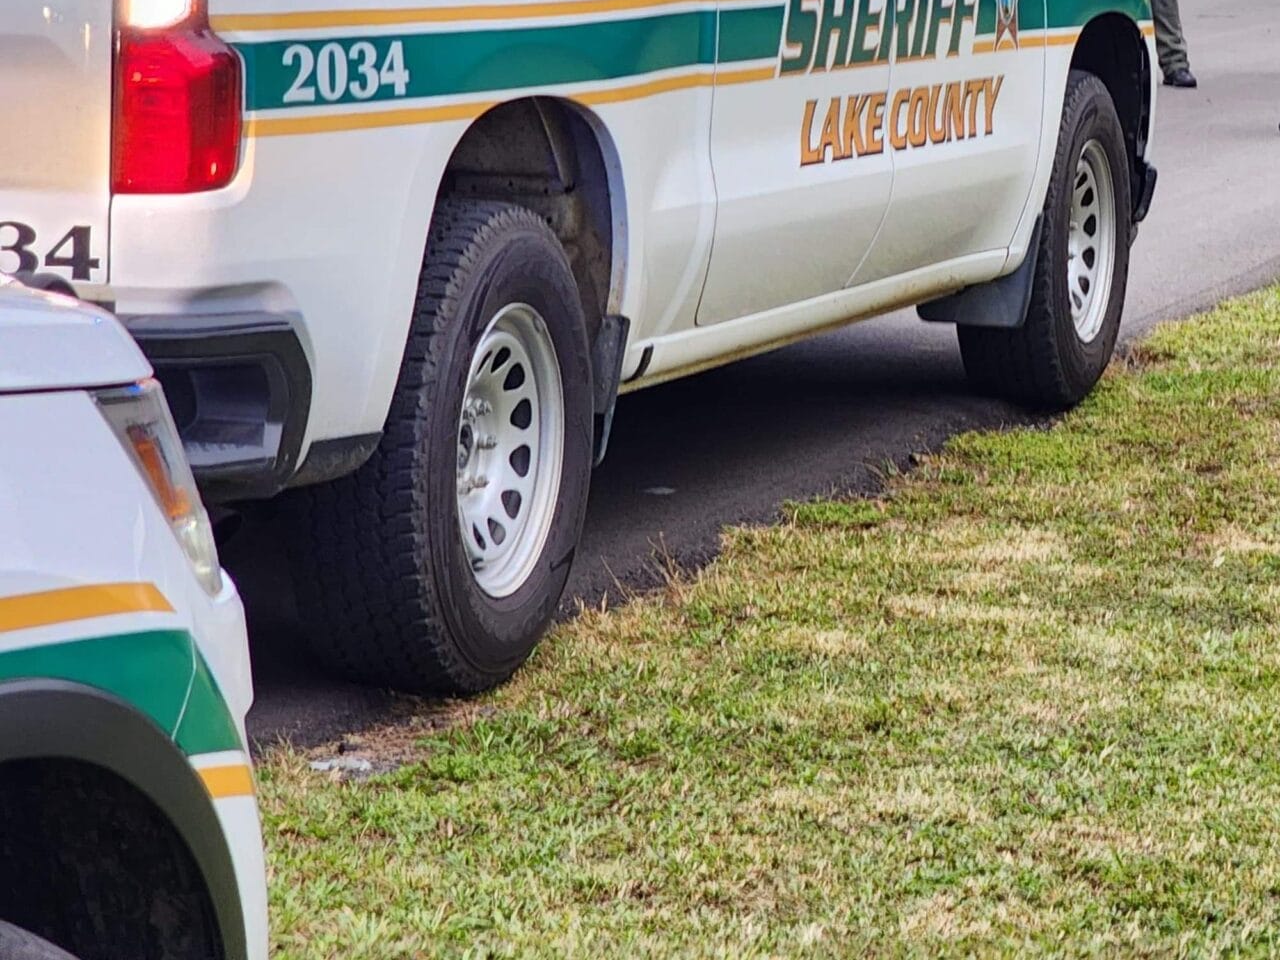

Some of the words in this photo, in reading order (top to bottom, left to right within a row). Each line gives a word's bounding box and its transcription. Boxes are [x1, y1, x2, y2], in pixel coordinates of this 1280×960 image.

[282, 40, 409, 103] 2034
[800, 91, 888, 167] LAKE
[889, 74, 1004, 151] COUNTY
